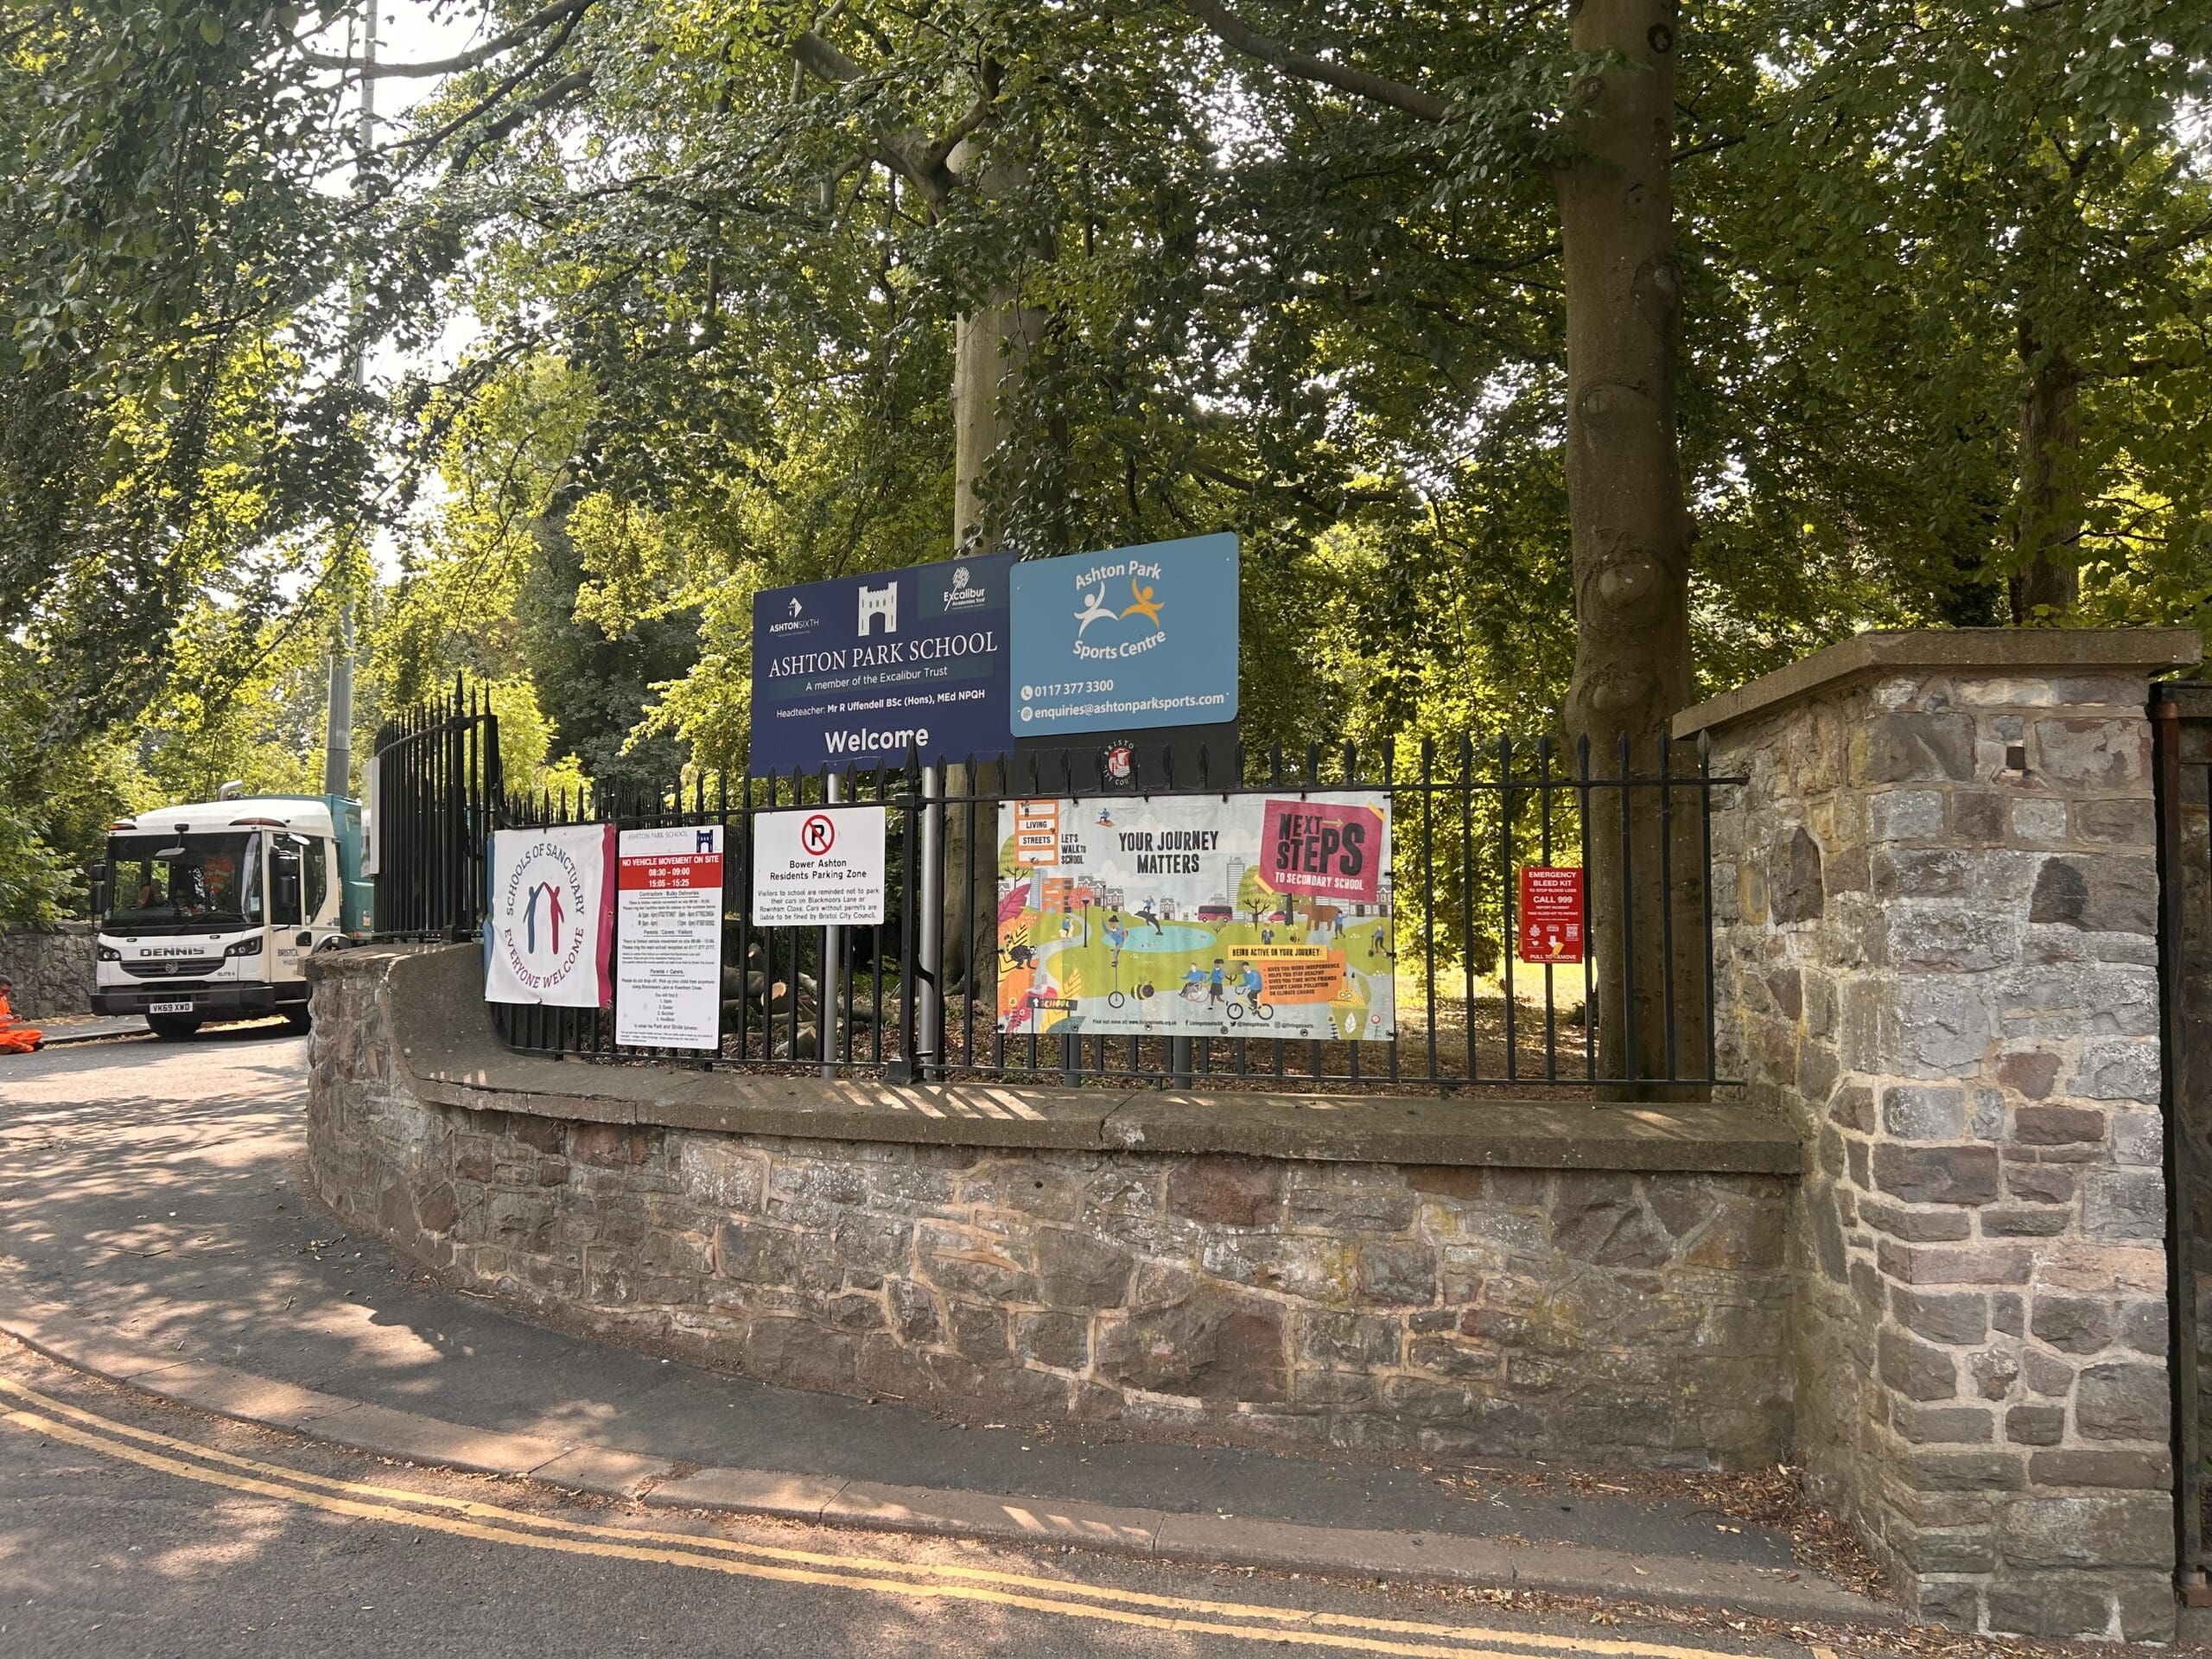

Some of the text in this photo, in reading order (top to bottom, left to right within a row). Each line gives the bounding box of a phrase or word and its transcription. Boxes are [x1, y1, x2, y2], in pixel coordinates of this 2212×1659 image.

[1076, 561, 1161, 590] Ashton Park
[944, 588, 985, 601] Excalibur
[770, 619, 819, 633] ASHTONSIXTH
[769, 631, 998, 677] ASHTON PARK SCHOOL
[1073, 631, 1166, 659] Sports Centre
[806, 666, 948, 691] A member of the Excalibur Trust
[1035, 679, 1114, 697] 0117 377 3300
[777, 690, 985, 718] Headteacher: Mr R Uffendell BSc (Hons), MEd NPQH
[1035, 694, 1224, 720] enquiries@ashtonparksports.com
[825, 728, 929, 753] Welcome
[628, 832, 650, 841] ASHTON
[1061, 834, 1079, 843] LET'S
[1279, 814, 1323, 841] NEXT
[1061, 845, 1080, 854] WALK
[1119, 830, 1219, 852] YOUR JOURNEY
[1276, 823, 1365, 876] STEPS
[1061, 855, 1084, 864] SCHOOL
[1137, 854, 1199, 874] MATTERS
[506, 843, 584, 916] SCHOOLS OF SANCTUARY
[770, 869, 867, 880] Residents Parking Zone
[1274, 873, 1363, 891] TO SECONDARY SCHOOL
[140, 947, 205, 957] DENNIS
[505, 928, 584, 989] EVERYONE WELCOME
